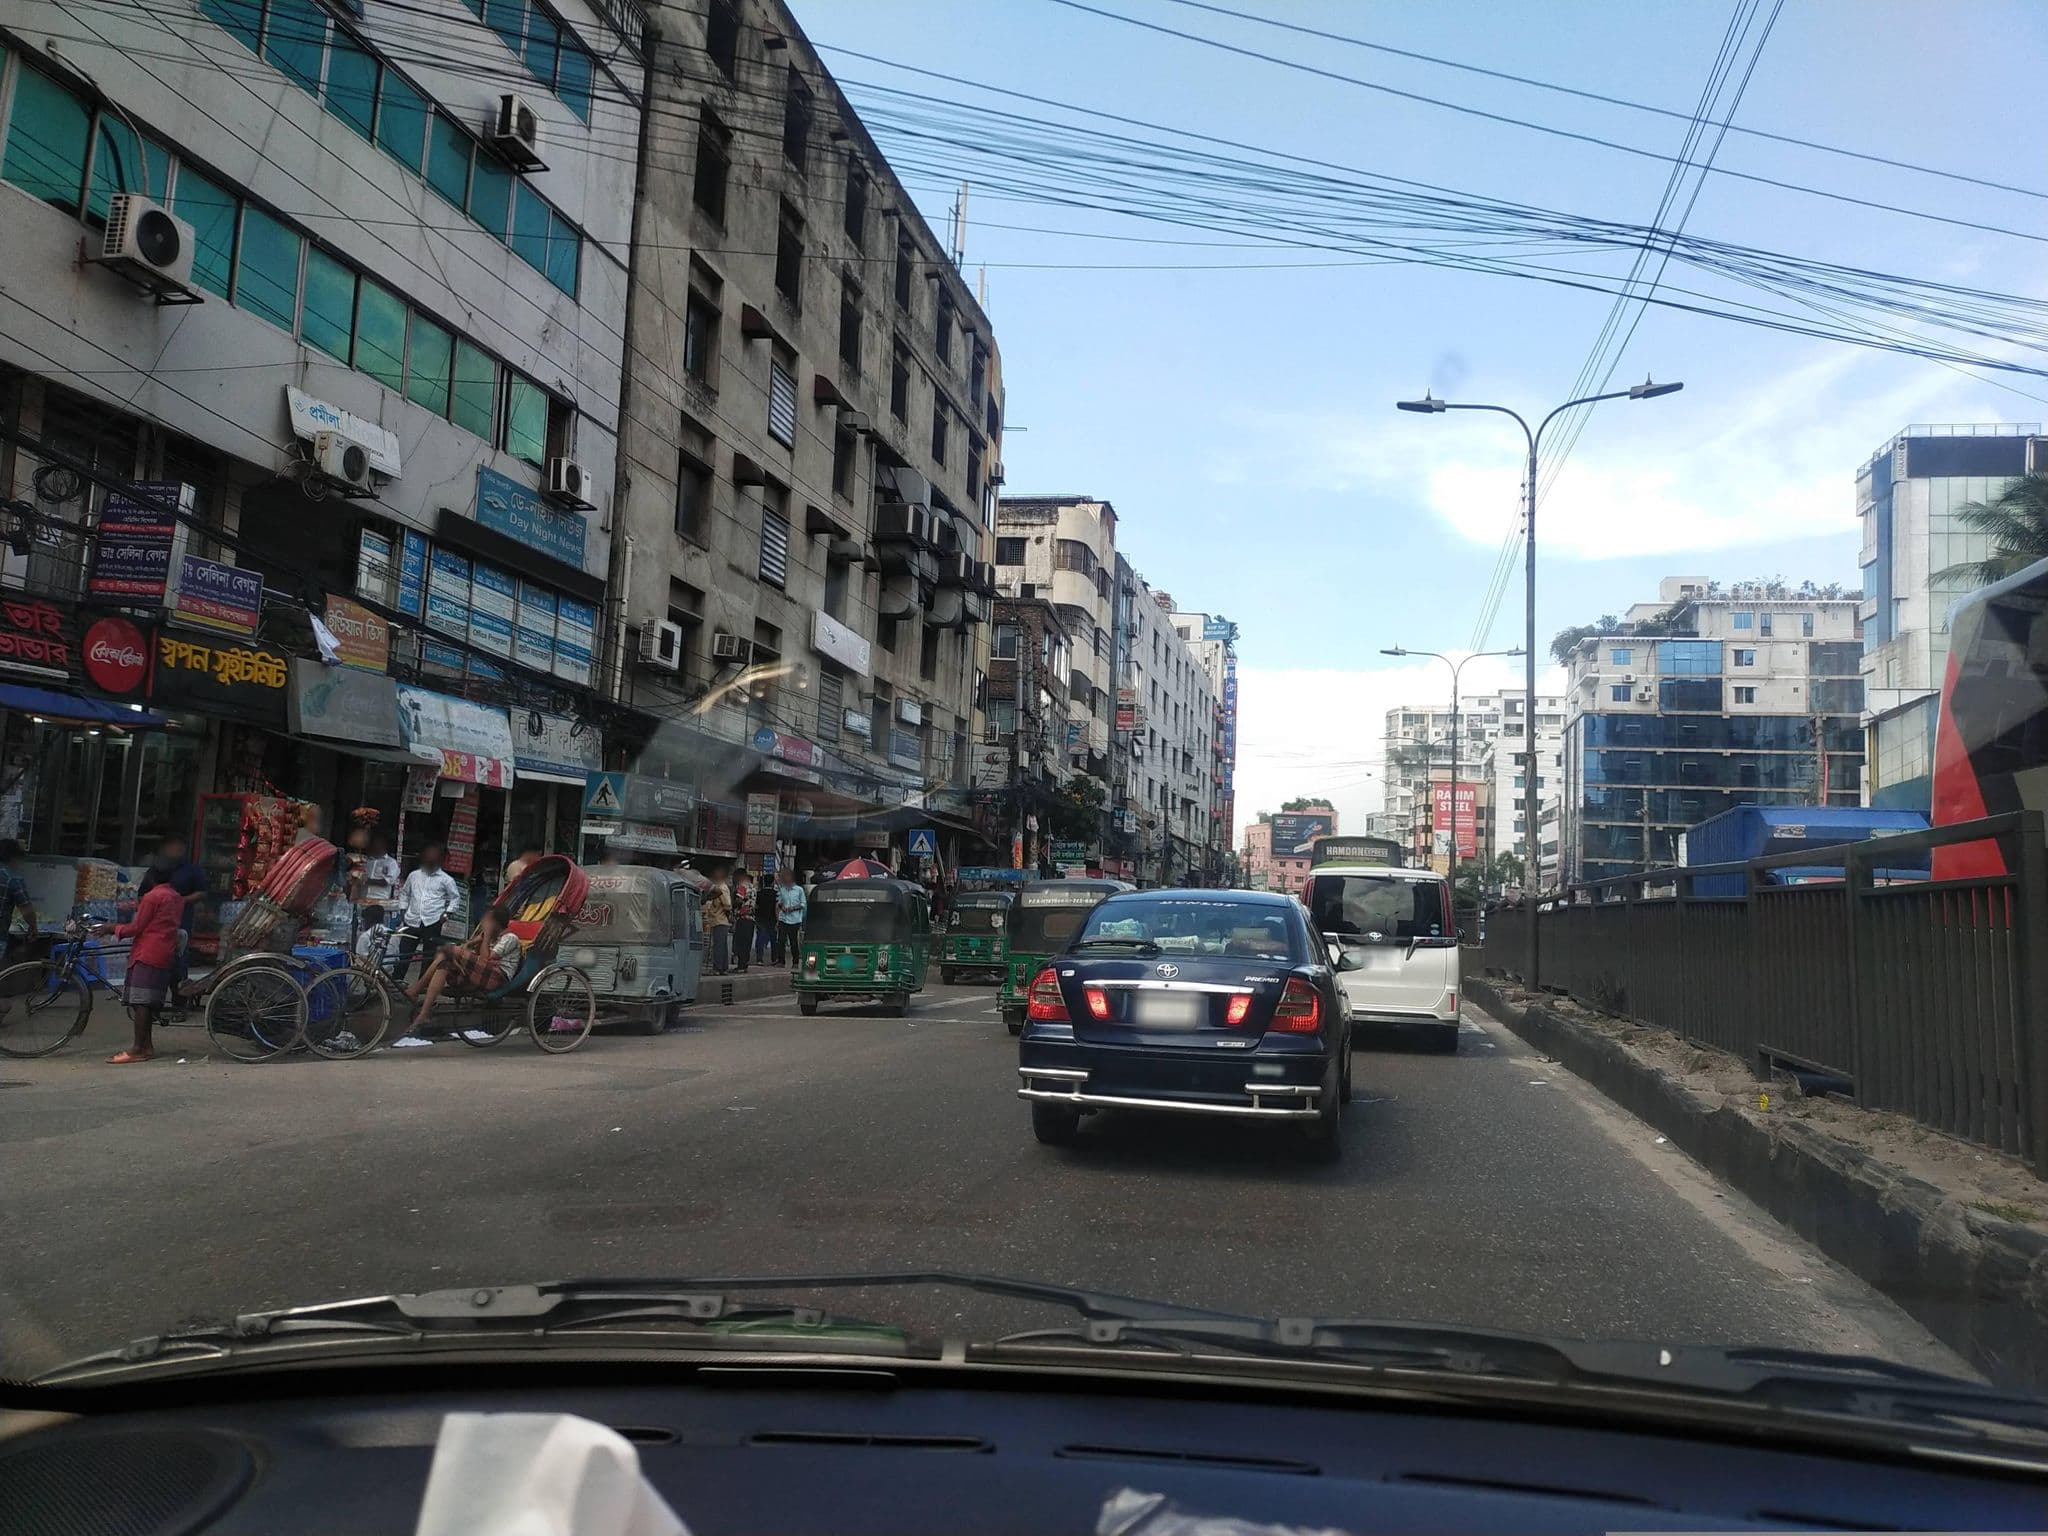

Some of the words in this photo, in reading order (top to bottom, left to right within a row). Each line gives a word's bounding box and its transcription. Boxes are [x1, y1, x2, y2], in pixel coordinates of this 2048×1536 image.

[510, 512, 529, 532] Day
[531, 523, 558, 544] Night
[559, 536, 584, 556] News
[116, 545, 145, 562] সেলিনা
[146, 549, 169, 562] বেগম
[196, 564, 230, 588] সেলিনা
[232, 575, 259, 595] বেগম
[159, 636, 211, 673] স্বপন
[1326, 845, 1364, 857] HAMDAN
[1244, 975, 1280, 984] PREMIO
